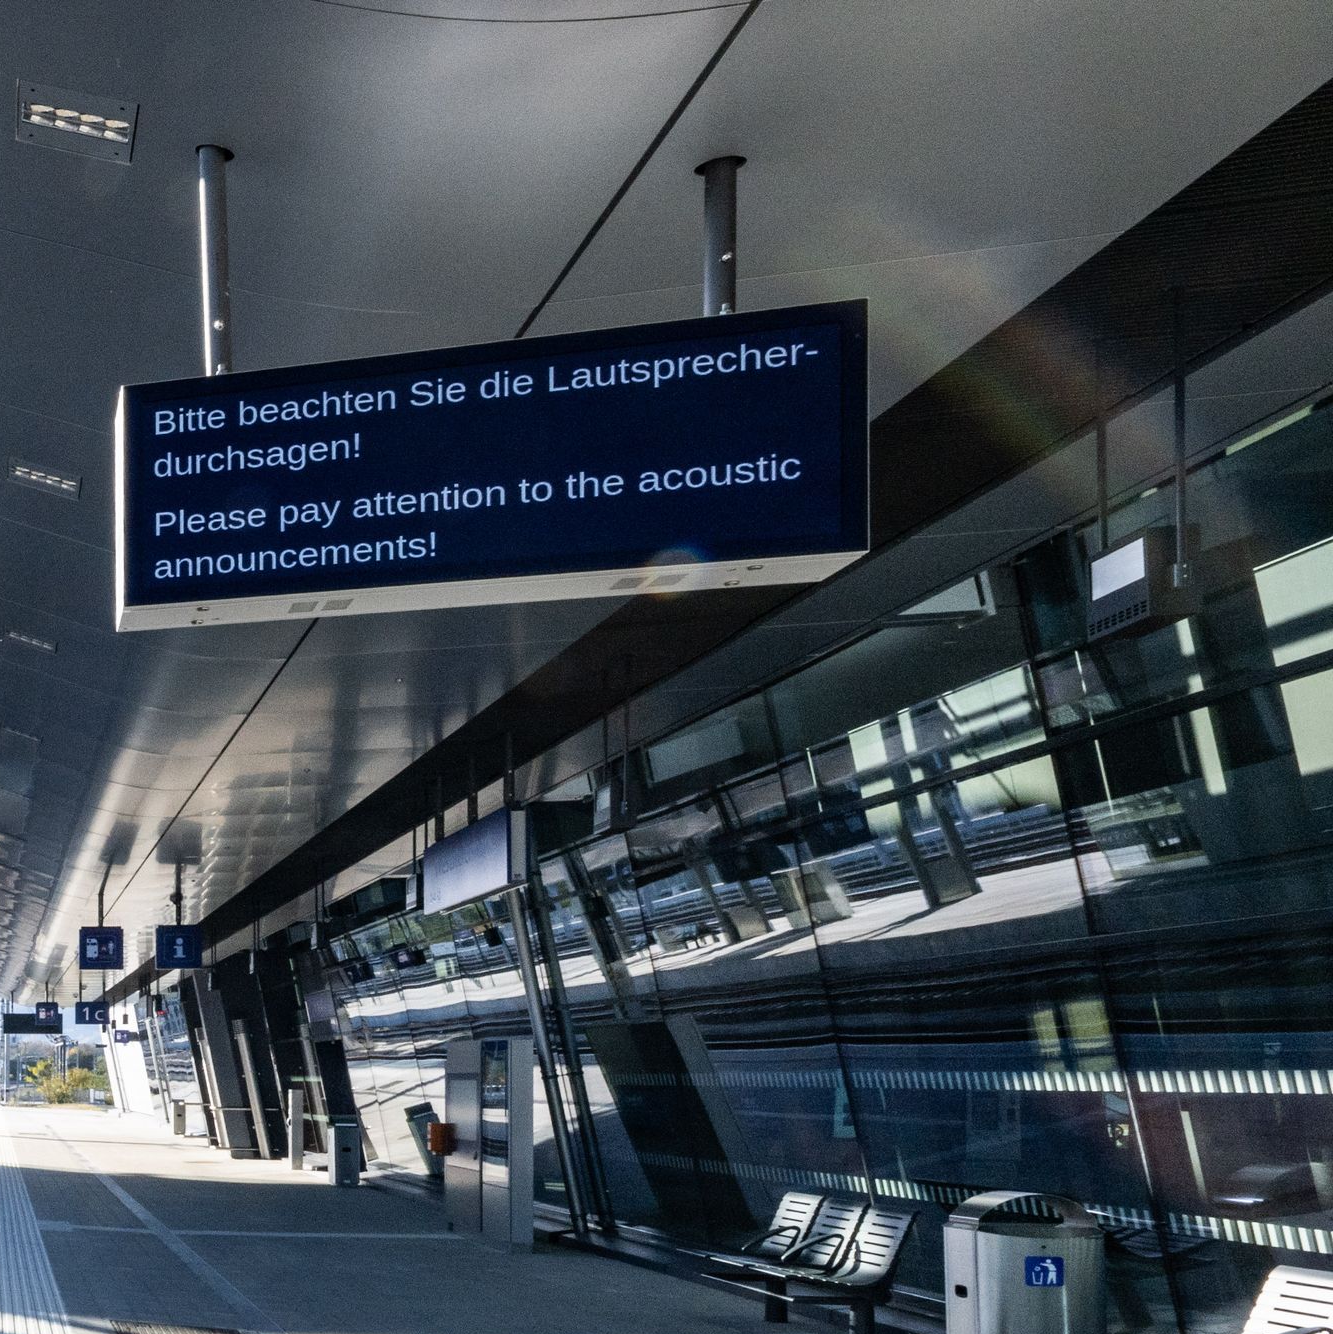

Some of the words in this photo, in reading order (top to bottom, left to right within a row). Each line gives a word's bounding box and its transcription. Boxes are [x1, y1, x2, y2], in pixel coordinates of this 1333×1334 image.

[154, 406, 227, 437] Bitte
[238, 389, 397, 427] beachten
[409, 379, 467, 408] Sie
[478, 370, 535, 400] die
[547, 342, 819, 393] Lautsprecher-
[153, 431, 362, 479] durchsagen!
[154, 506, 268, 538] Please
[279, 499, 342, 534] pay
[351, 482, 507, 520] attention
[518, 477, 554, 505] to
[564, 470, 625, 501] the
[637, 453, 802, 494] acoustic
[153, 530, 438, 580] announcements!
